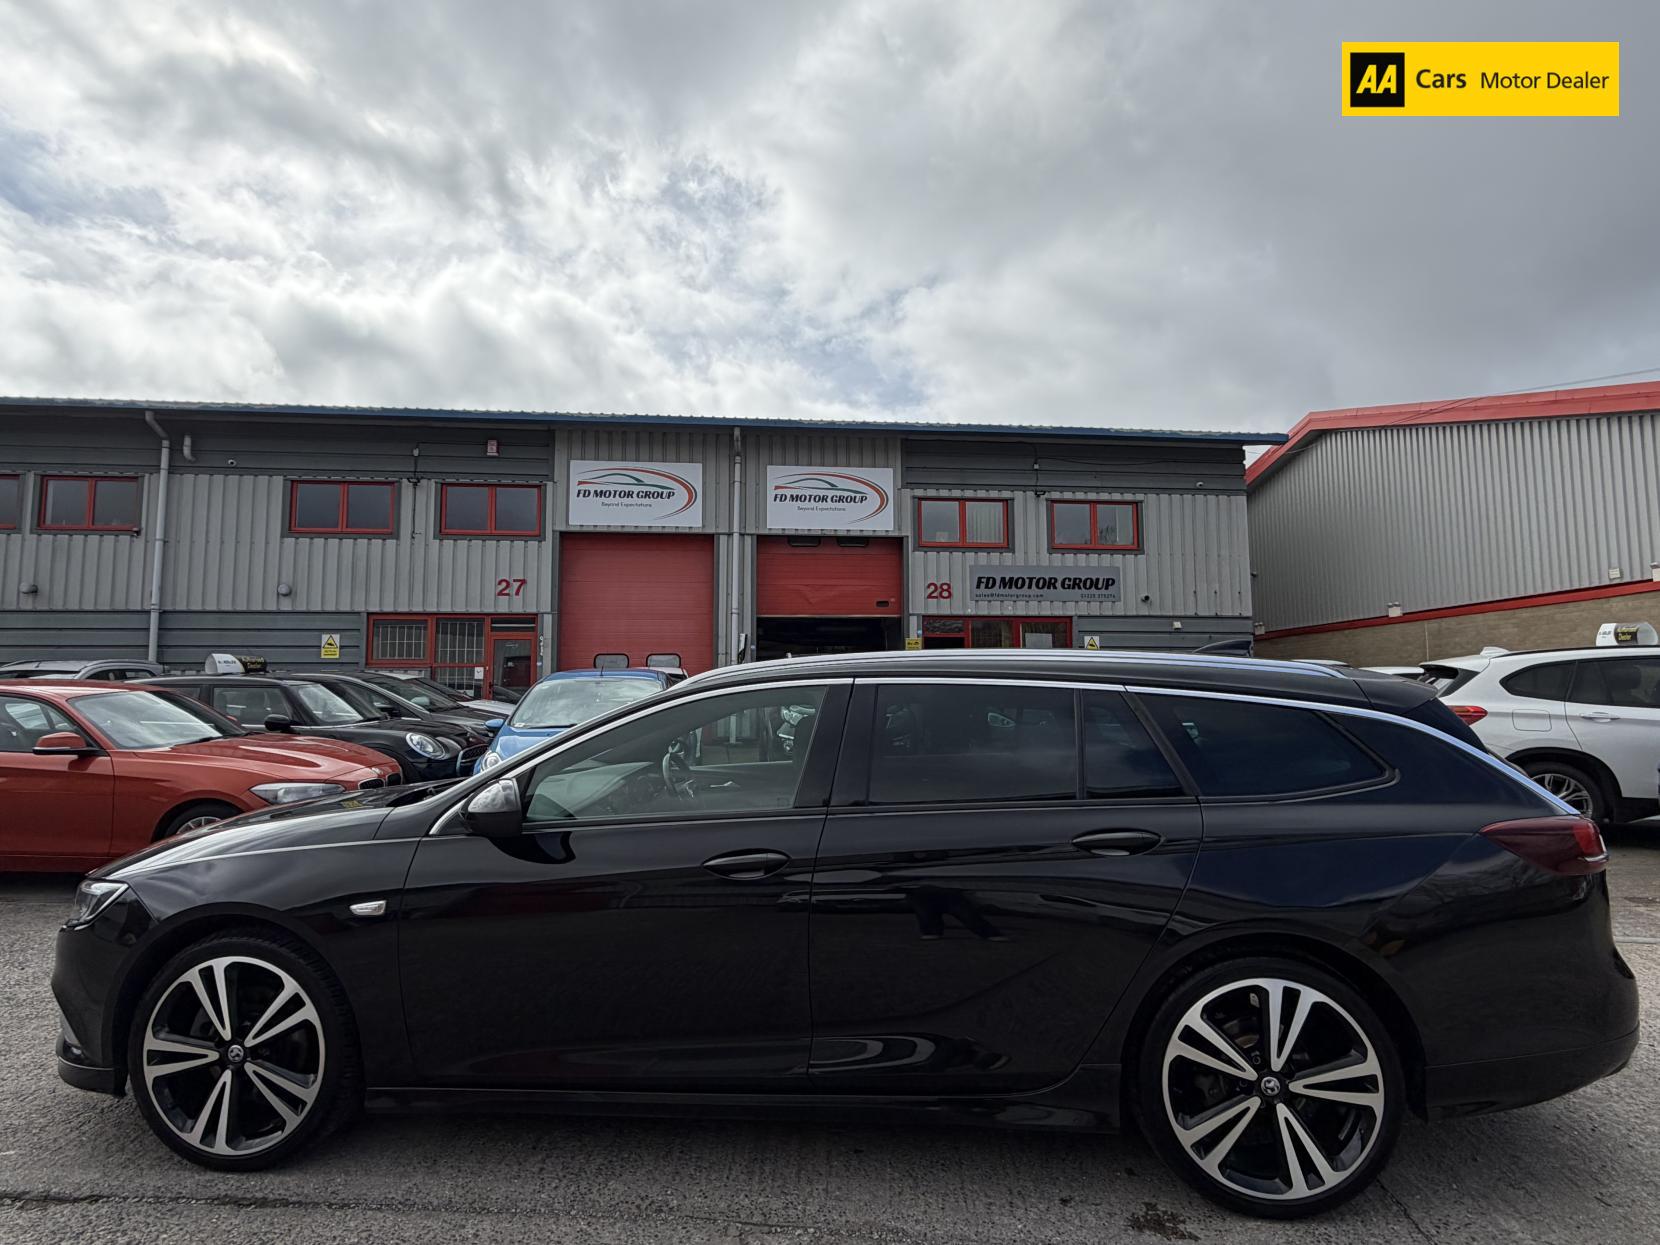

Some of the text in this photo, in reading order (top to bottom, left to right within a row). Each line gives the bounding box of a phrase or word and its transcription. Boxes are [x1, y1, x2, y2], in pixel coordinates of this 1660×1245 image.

[576, 489, 675, 500] FD MOTOR GROUP
[773, 493, 868, 504] FD MOTOR GROUP
[496, 578, 527, 597] 27
[926, 582, 952, 600] 28
[975, 576, 1116, 591] FD MOTOR GROUP
